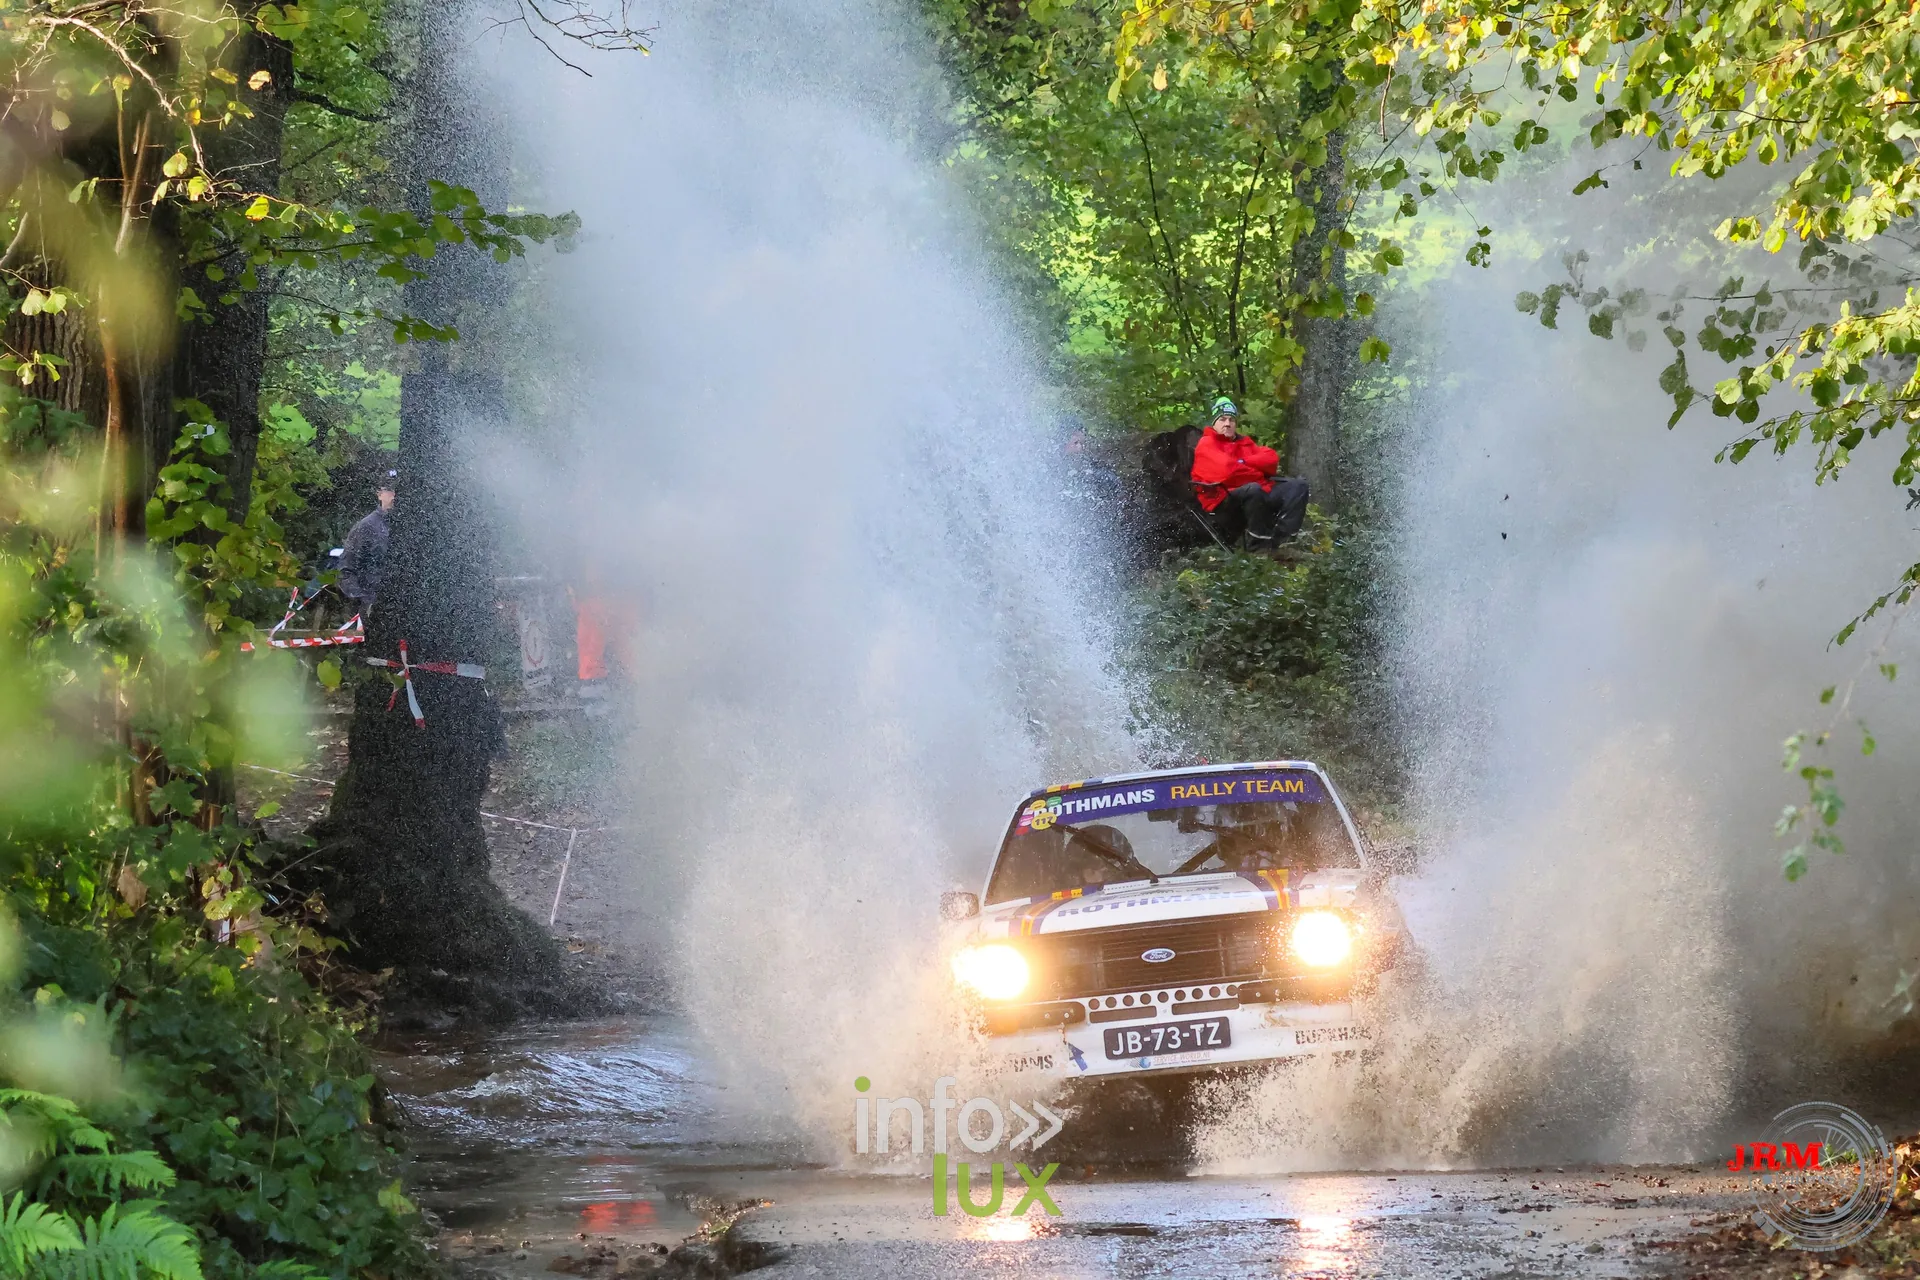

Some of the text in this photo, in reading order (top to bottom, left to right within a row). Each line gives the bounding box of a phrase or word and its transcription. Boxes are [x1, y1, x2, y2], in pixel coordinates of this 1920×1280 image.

[1170, 781, 1236, 799] RALLY
[1242, 779, 1304, 793] TEAM
[1057, 890, 1251, 917] ROTHMANS
[1112, 1022, 1222, 1056] JB-73-TZ
